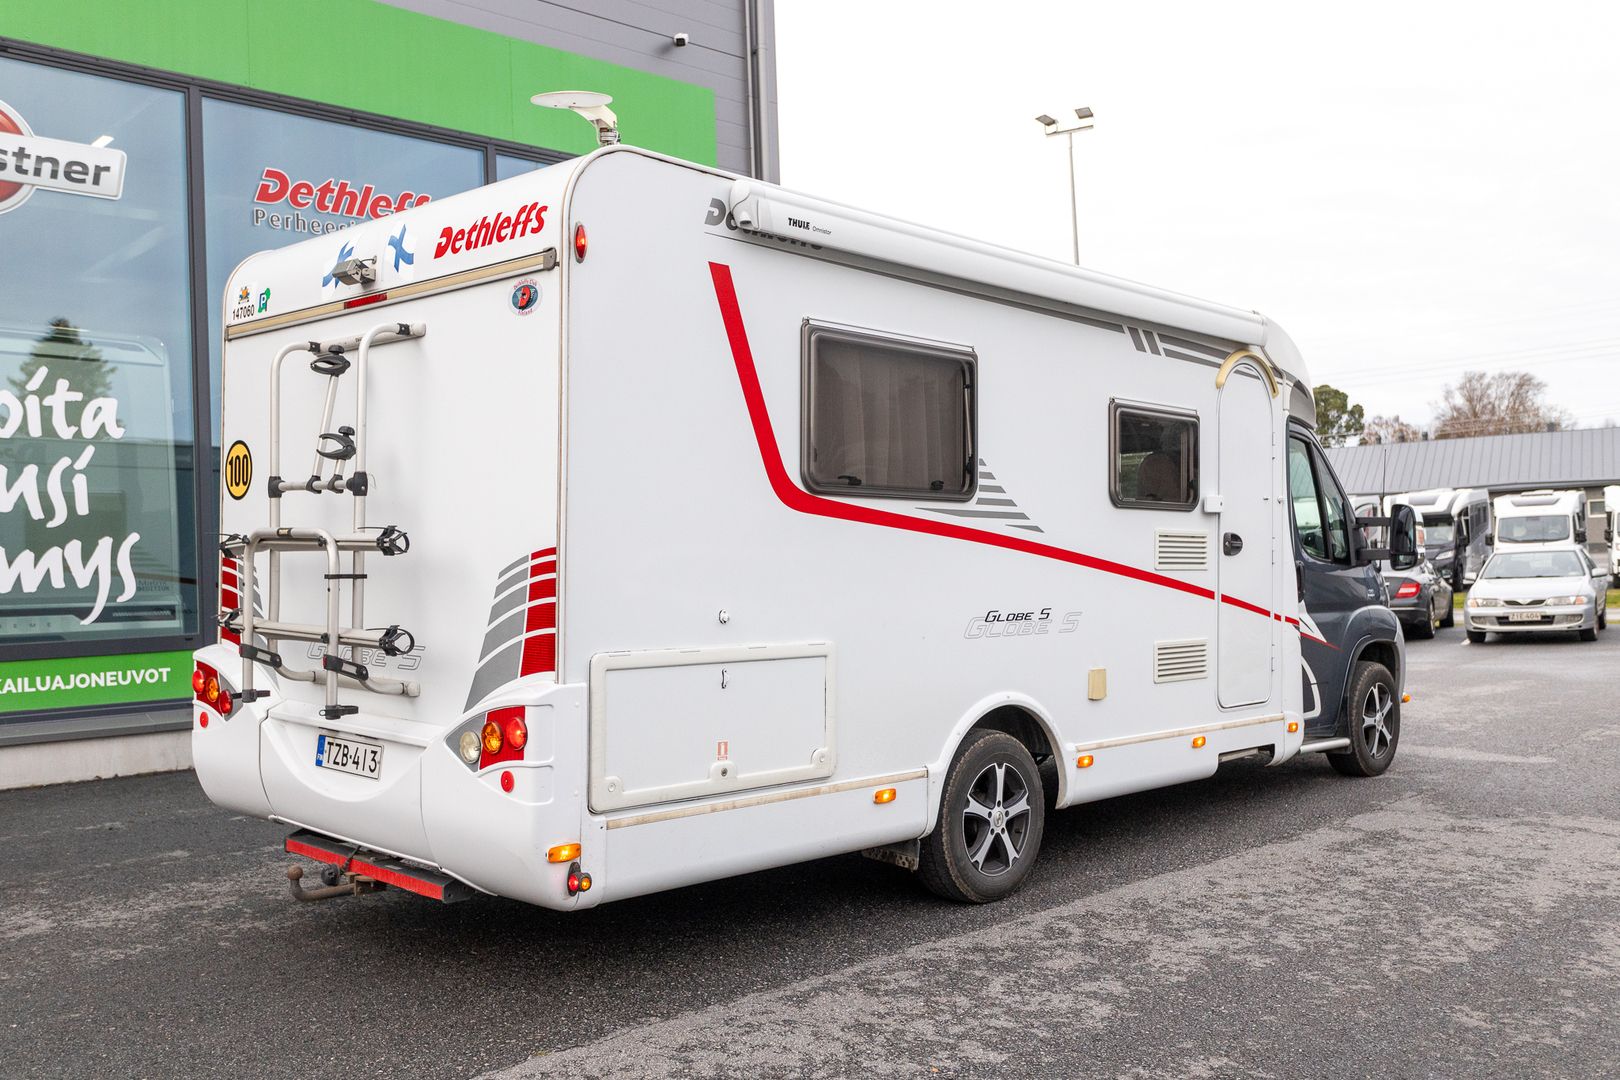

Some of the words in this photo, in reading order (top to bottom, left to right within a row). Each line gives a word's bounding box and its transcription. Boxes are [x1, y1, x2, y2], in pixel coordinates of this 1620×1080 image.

[254, 167, 432, 219] Dethlef
[434, 202, 548, 259] Dethleffs
[788, 217, 810, 230] THULE
[233, 304, 254, 320] 147060
[229, 454, 248, 487] 100
[1038, 608, 1051, 620] S
